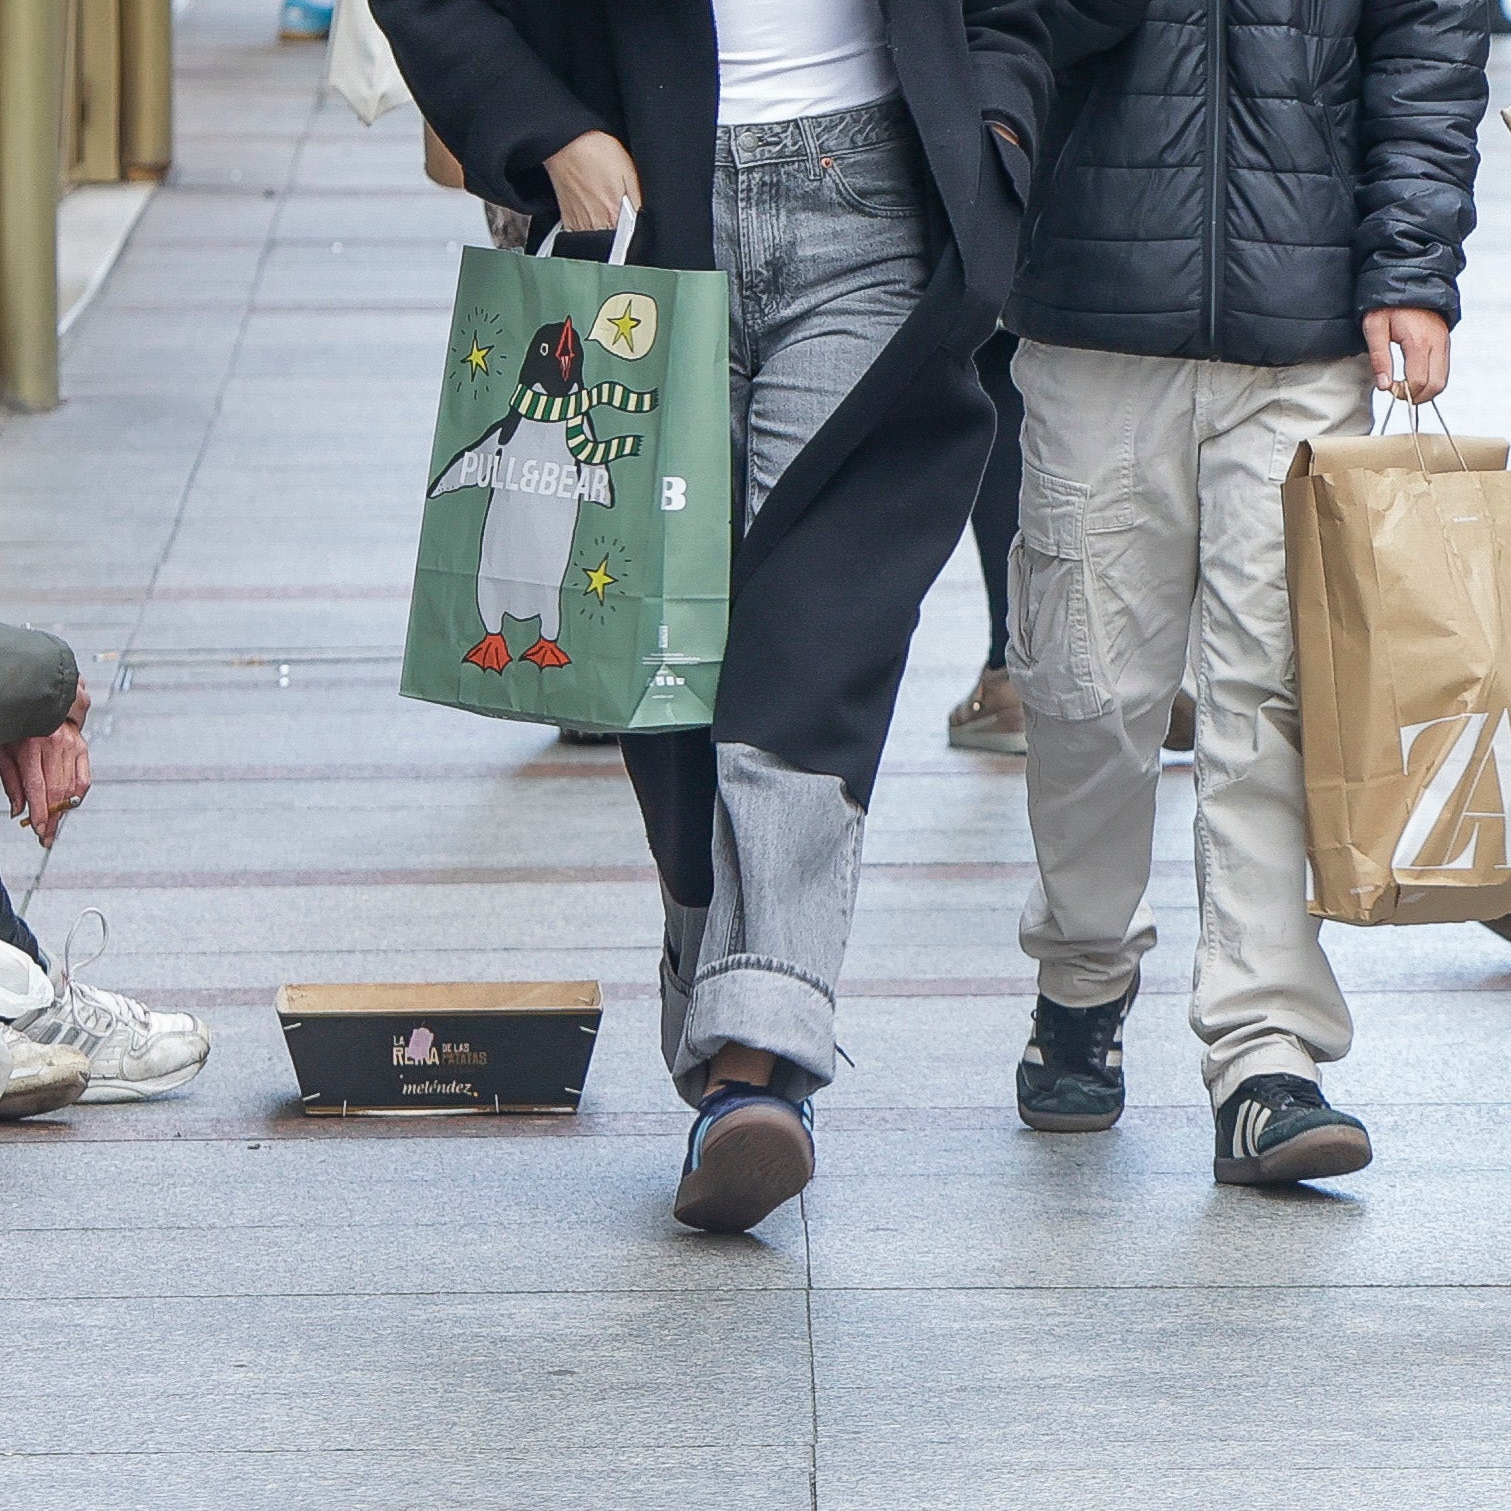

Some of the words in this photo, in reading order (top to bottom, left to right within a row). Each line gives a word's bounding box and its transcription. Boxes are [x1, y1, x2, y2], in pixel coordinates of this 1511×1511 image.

[459, 451, 610, 503] PULL&BEAR
[392, 1035, 405, 1045] LA
[442, 1043, 451, 1052] DE
[453, 1042, 470, 1052] LAS
